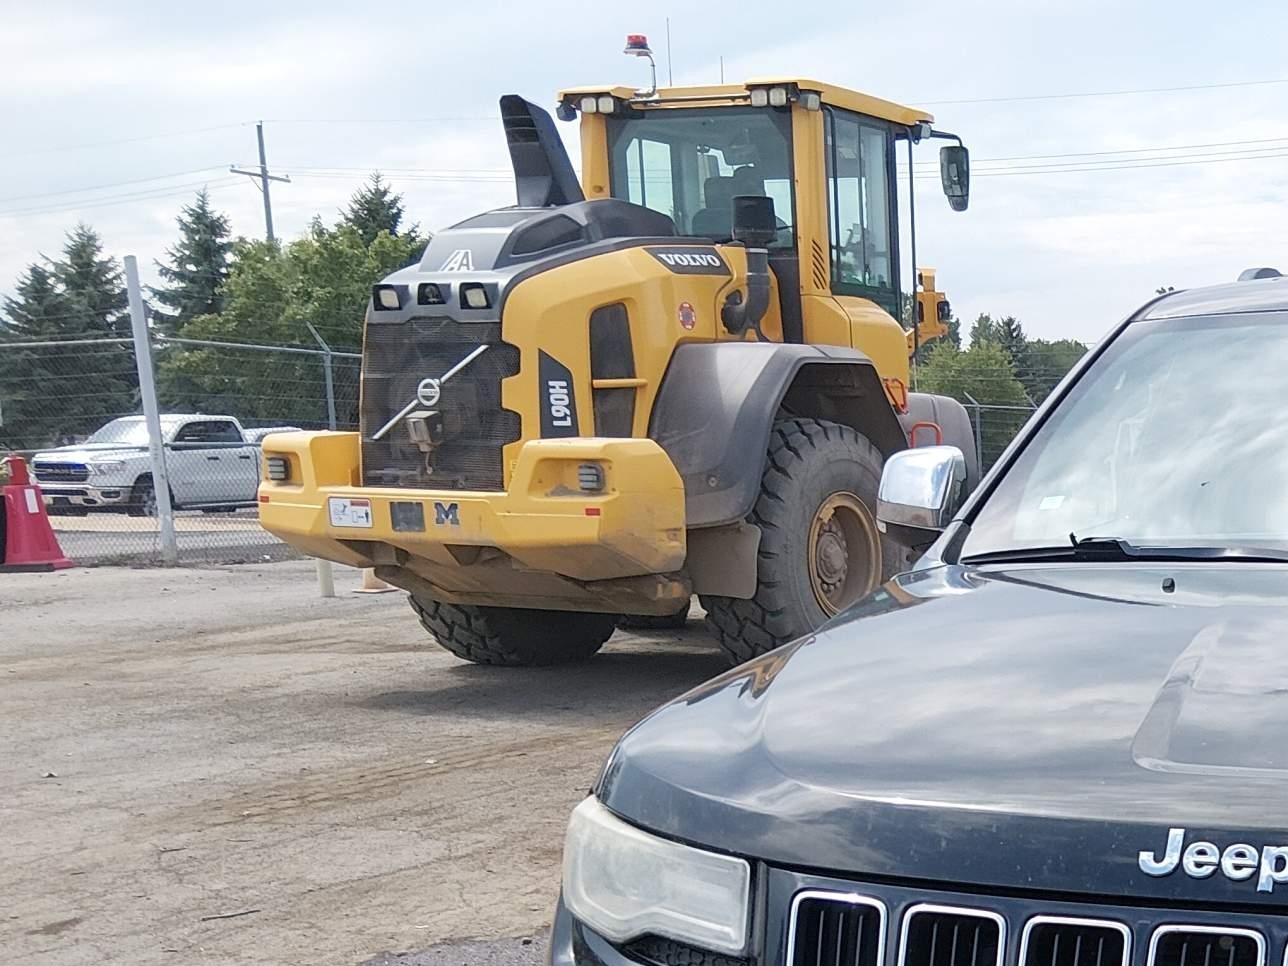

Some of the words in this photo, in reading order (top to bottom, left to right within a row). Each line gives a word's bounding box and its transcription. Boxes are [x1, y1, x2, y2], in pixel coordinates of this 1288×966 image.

[657, 253, 721, 267] VOLVO
[547, 380, 573, 426] L90H
[433, 501, 460, 526] M
